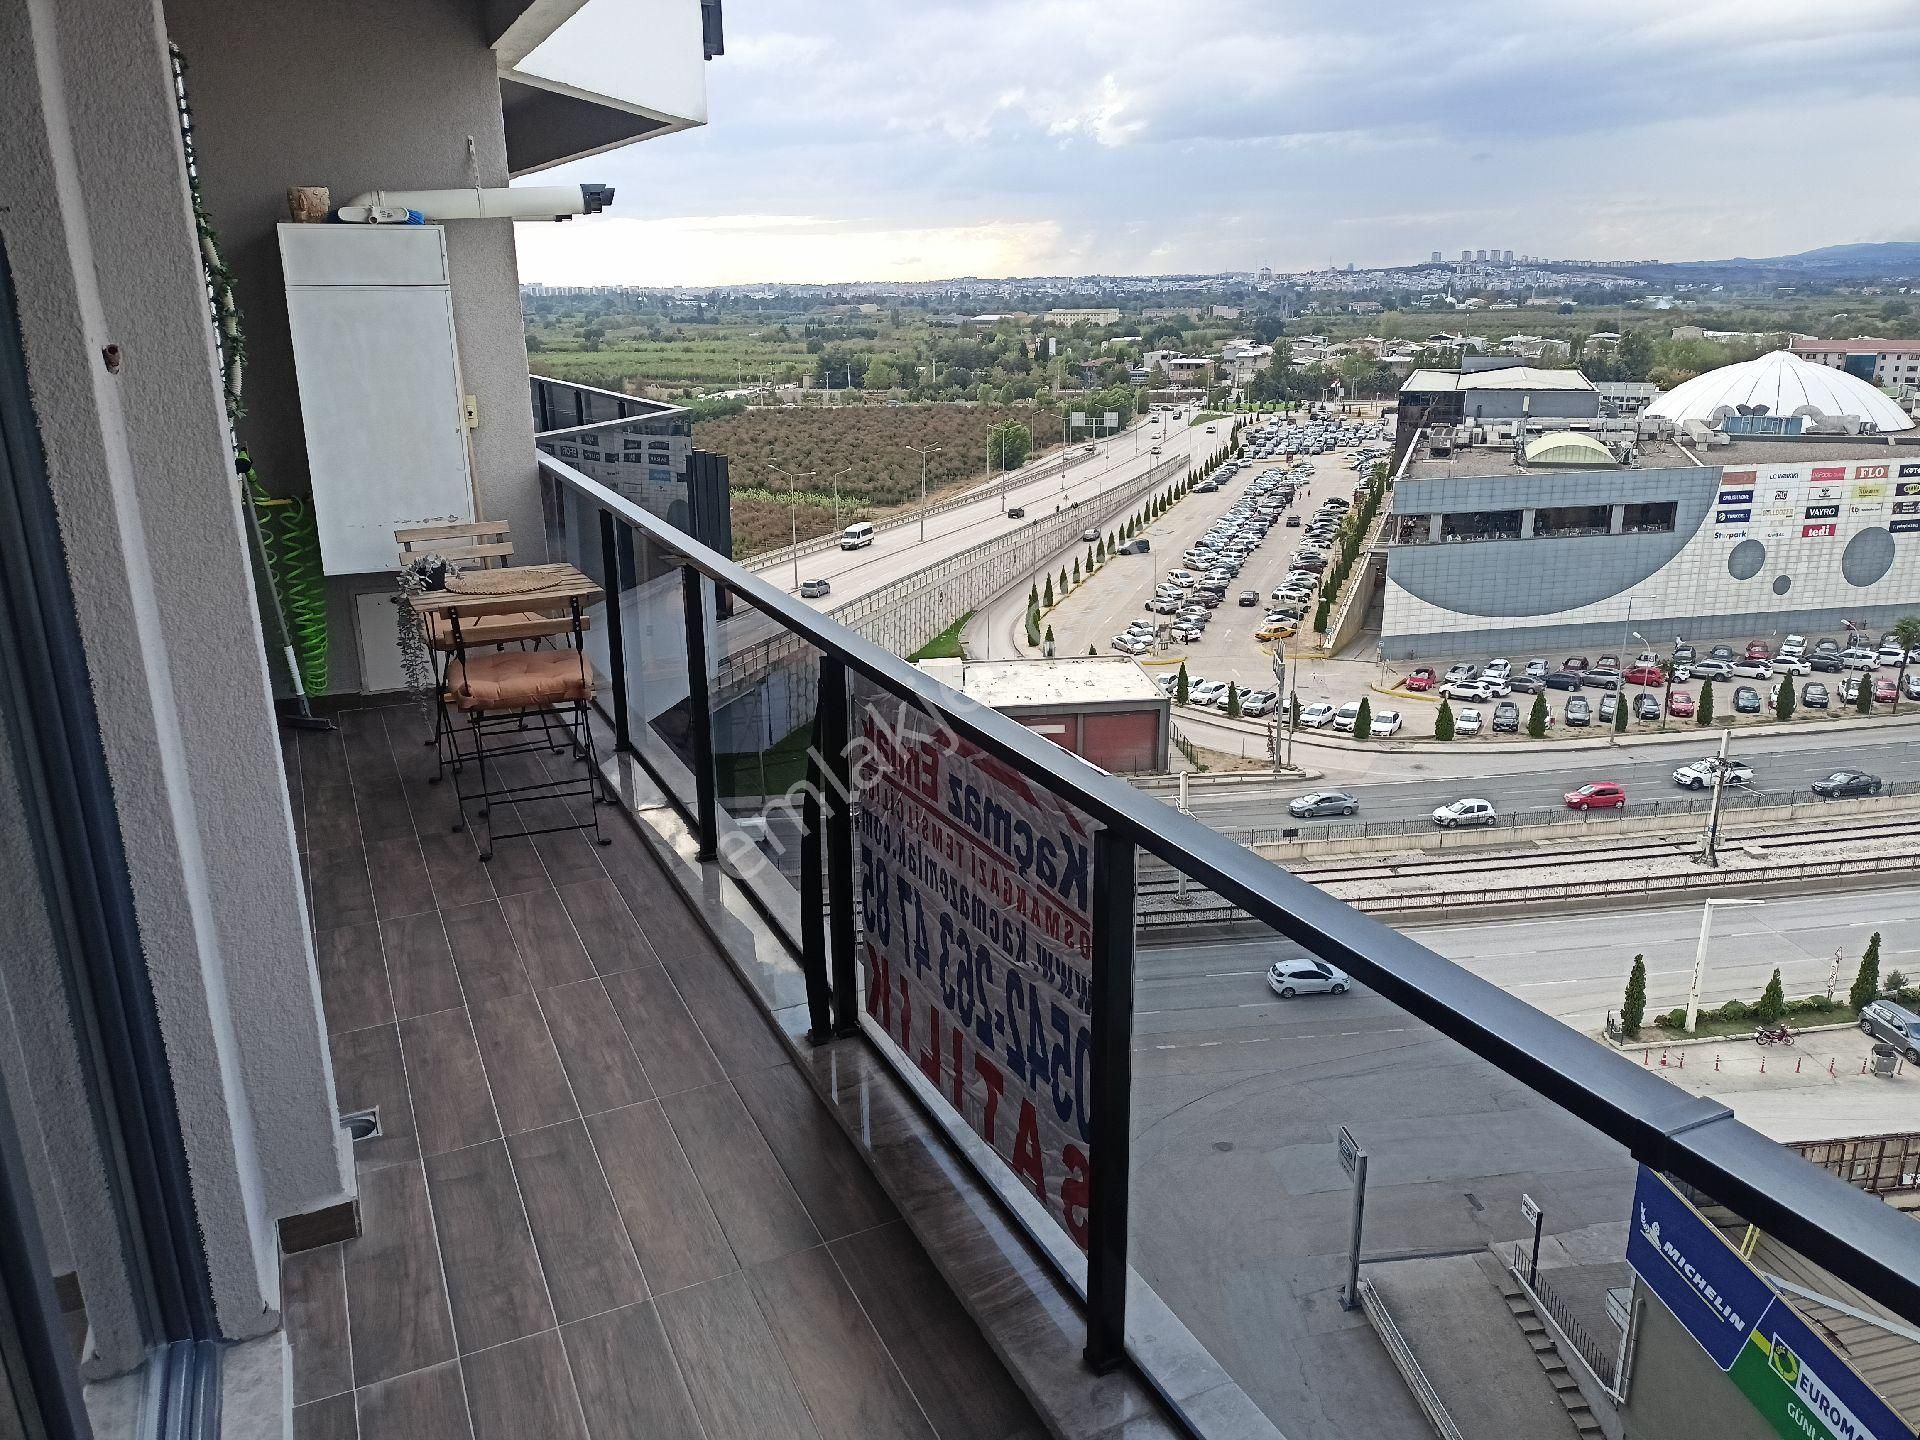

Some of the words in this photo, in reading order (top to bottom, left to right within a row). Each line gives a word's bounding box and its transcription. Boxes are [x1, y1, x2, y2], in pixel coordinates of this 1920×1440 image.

[1859, 467, 1885, 478] FLO
[1809, 507, 1836, 516] VAYRO
[1663, 1242, 1746, 1332] MICHELIN
[1787, 1402, 1824, 1440] GÜNL
